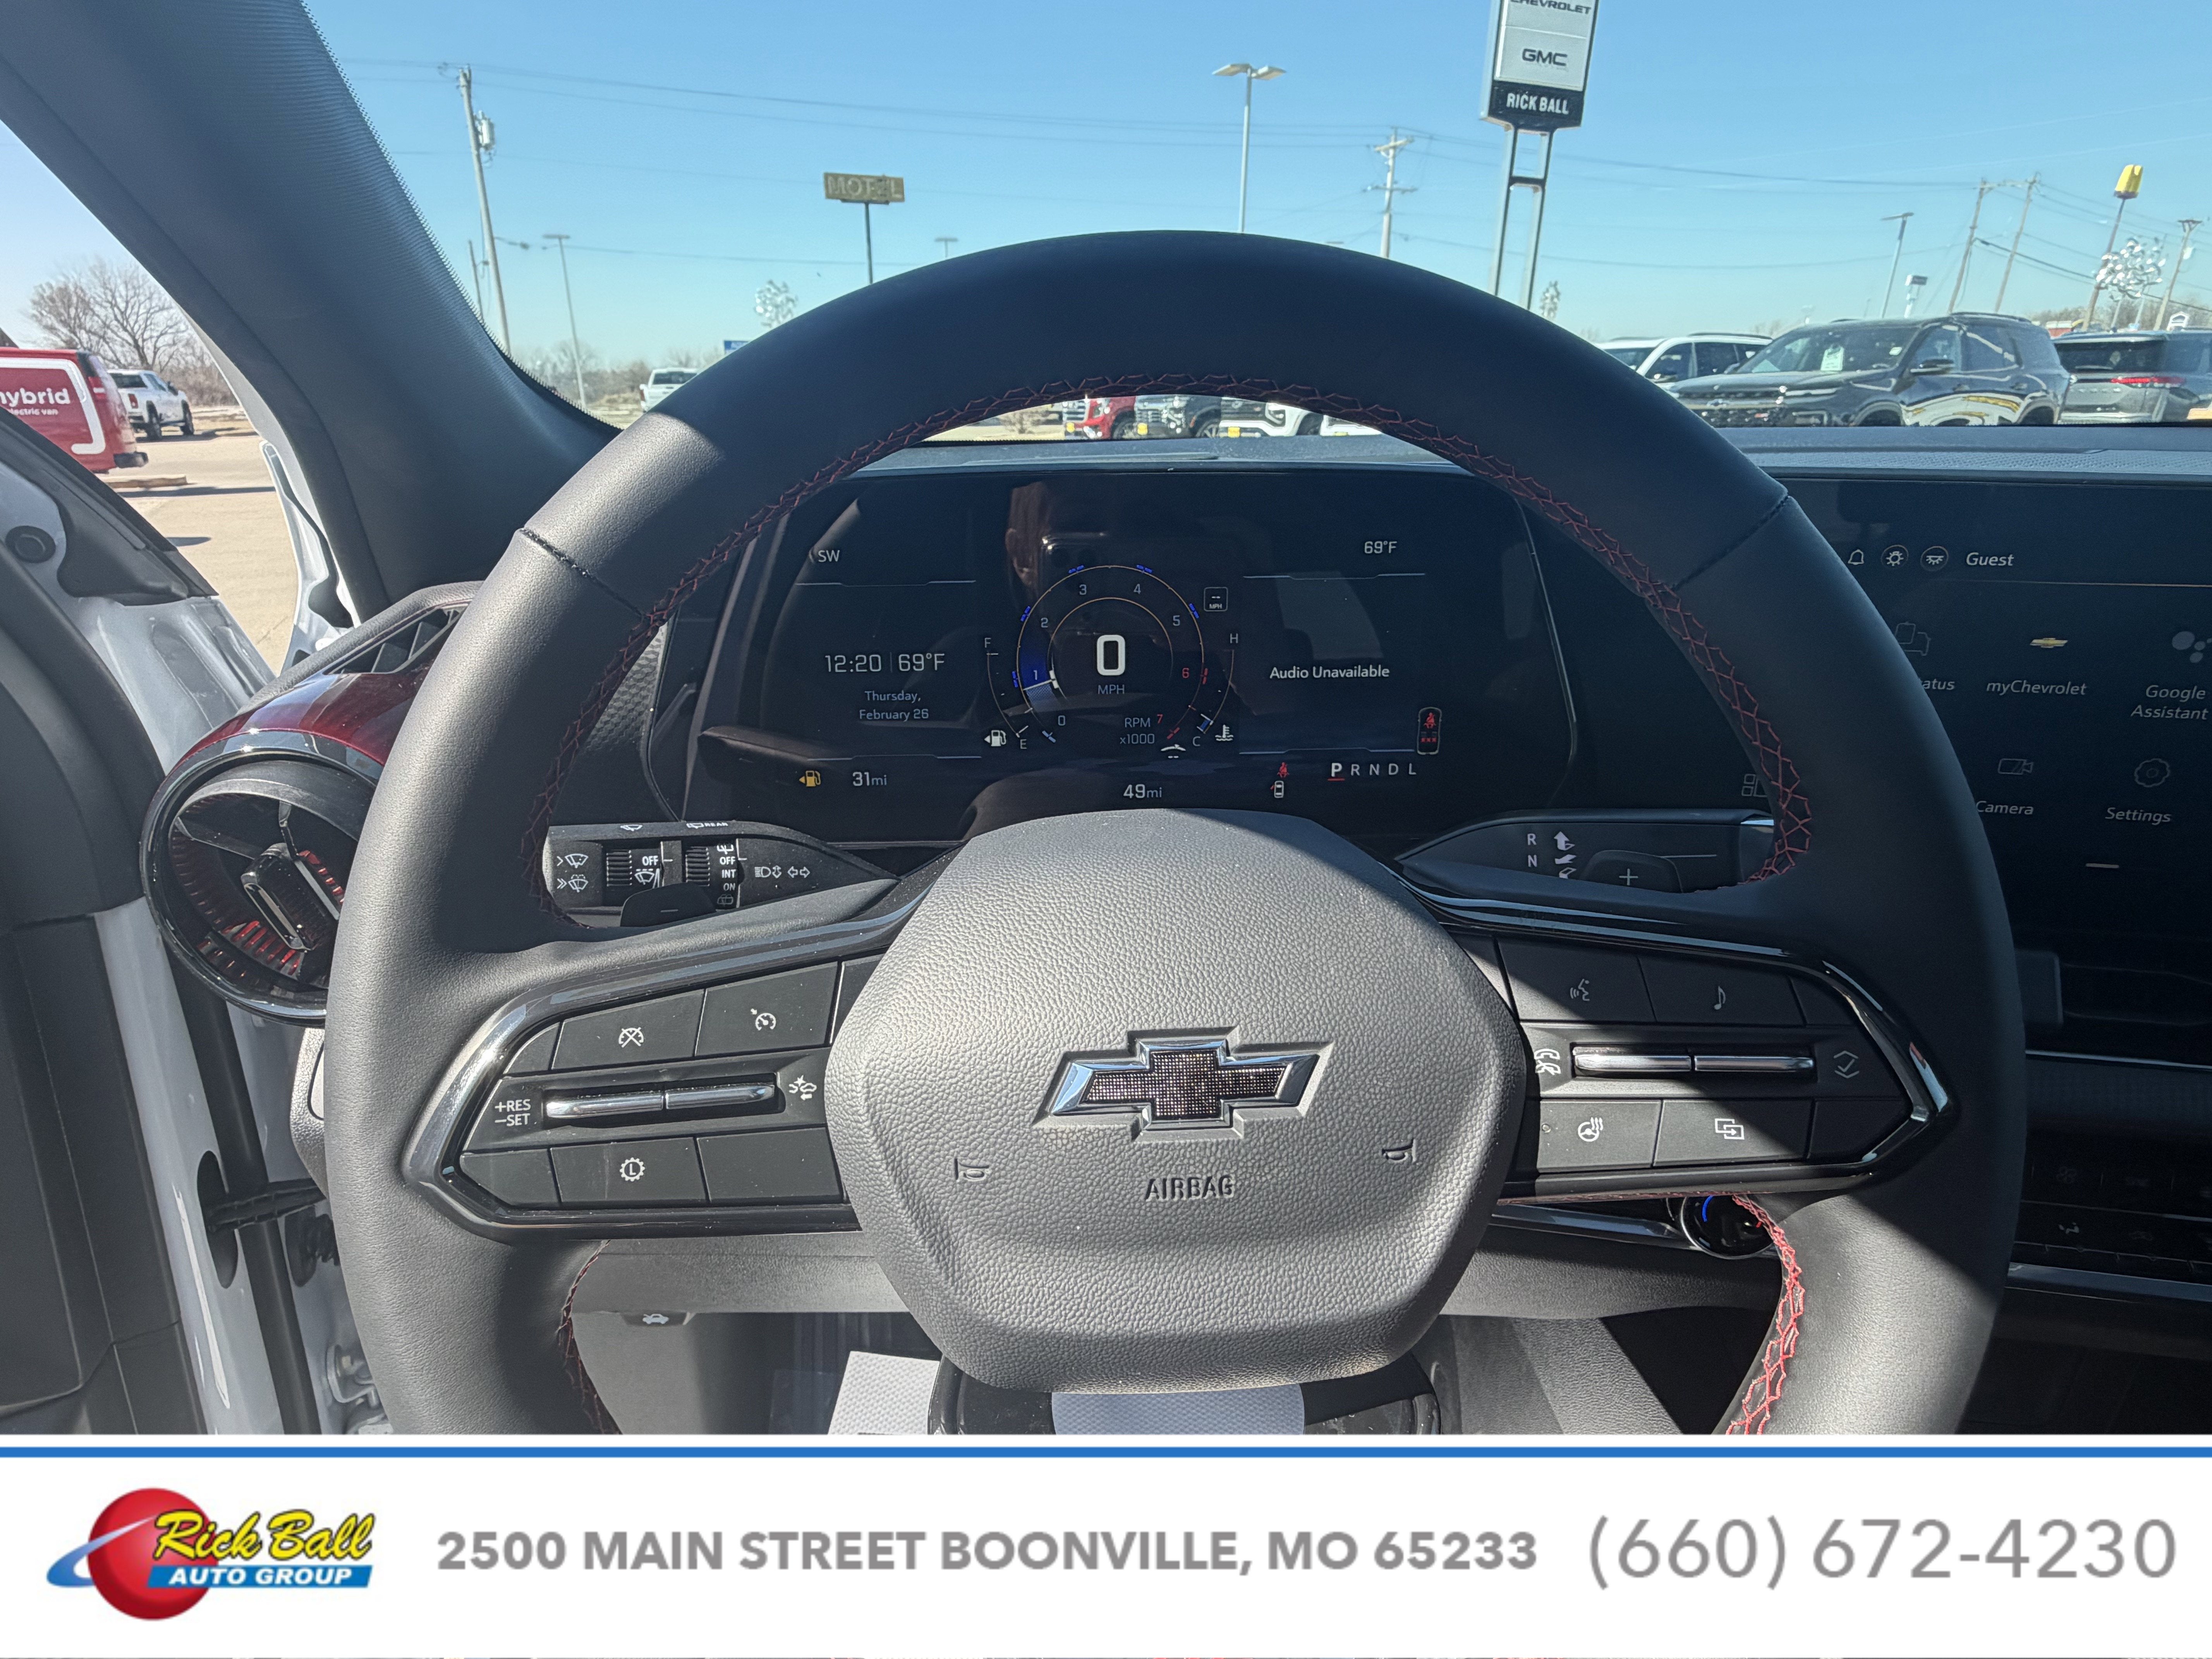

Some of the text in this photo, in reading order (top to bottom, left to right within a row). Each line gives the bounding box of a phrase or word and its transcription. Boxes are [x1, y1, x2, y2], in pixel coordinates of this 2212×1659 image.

[1522, 48, 1568, 66] GMC
[1506, 93, 1569, 115] RICK BALL
[9, 407, 40, 416] lectric
[1364, 541, 1397, 554] 69°F
[818, 550, 840, 562] SW
[1966, 551, 2014, 566] Guest
[1079, 584, 1087, 595] 3
[1133, 584, 1141, 594] 4
[1041, 618, 1049, 627] 2
[1173, 616, 1180, 625] 5
[985, 638, 991, 648] F
[1230, 634, 1238, 643] H
[1097, 634, 1125, 676] 0
[825, 653, 945, 673] 12:20 69°F
[1034, 670, 1037, 680] 1
[1182, 668, 1189, 678] 6
[1270, 665, 1389, 679] Audio Unavailable
[1098, 684, 1125, 694] MPH
[1919, 678, 1955, 690] atus
[1986, 680, 2087, 696] myChevrolet
[865, 691, 921, 702] Thursday,
[2145, 685, 2205, 701] Google
[859, 709, 929, 721] February 26
[1157, 714, 1163, 723] 7
[2131, 705, 2209, 720] Assistant
[1058, 716, 1066, 726] 0
[1125, 718, 1151, 727] RPM
[1020, 740, 1027, 749] E
[1120, 733, 1155, 745] x1000
[1192, 737, 1200, 747] C
[1331, 763, 1417, 777] P R N D L
[1975, 800, 2034, 815] Camera
[2105, 807, 2171, 825] Settings
[1527, 833, 1536, 845] R
[642, 855, 658, 866] OFF
[720, 856, 736, 865] OFF
[1528, 855, 1537, 867] N
[722, 869, 736, 878] INT
[723, 883, 735, 891] ON
[495, 1099, 531, 1112] +RES
[1145, 1175, 1234, 1200] AIRBAG
